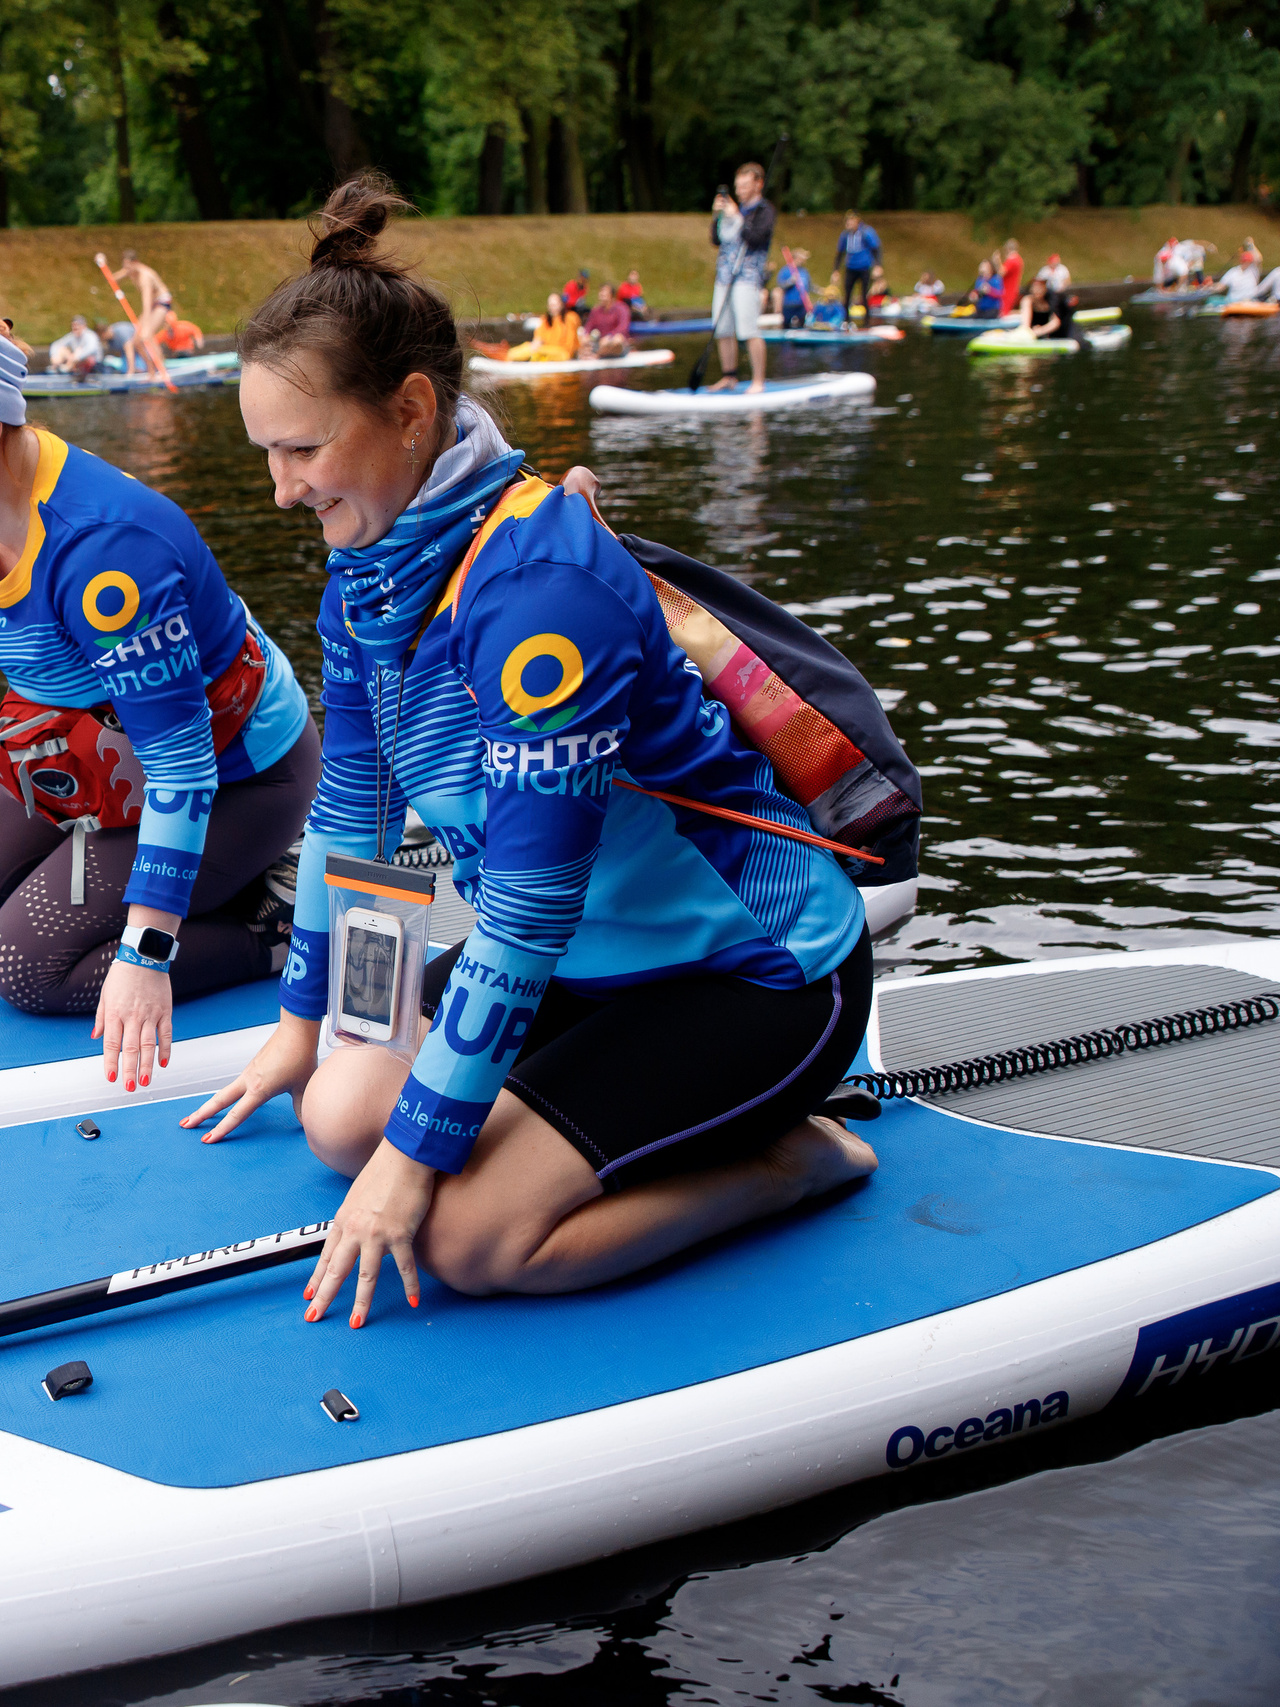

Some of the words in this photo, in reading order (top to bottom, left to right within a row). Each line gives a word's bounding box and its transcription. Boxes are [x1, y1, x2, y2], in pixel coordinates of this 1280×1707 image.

[90, 613, 190, 669] ента
[145, 787, 215, 823] UP
[454, 951, 547, 999] ОНТАНКА
[1134, 1314, 1280, 1398] HYD
[885, 1390, 1070, 1470] Oceana
